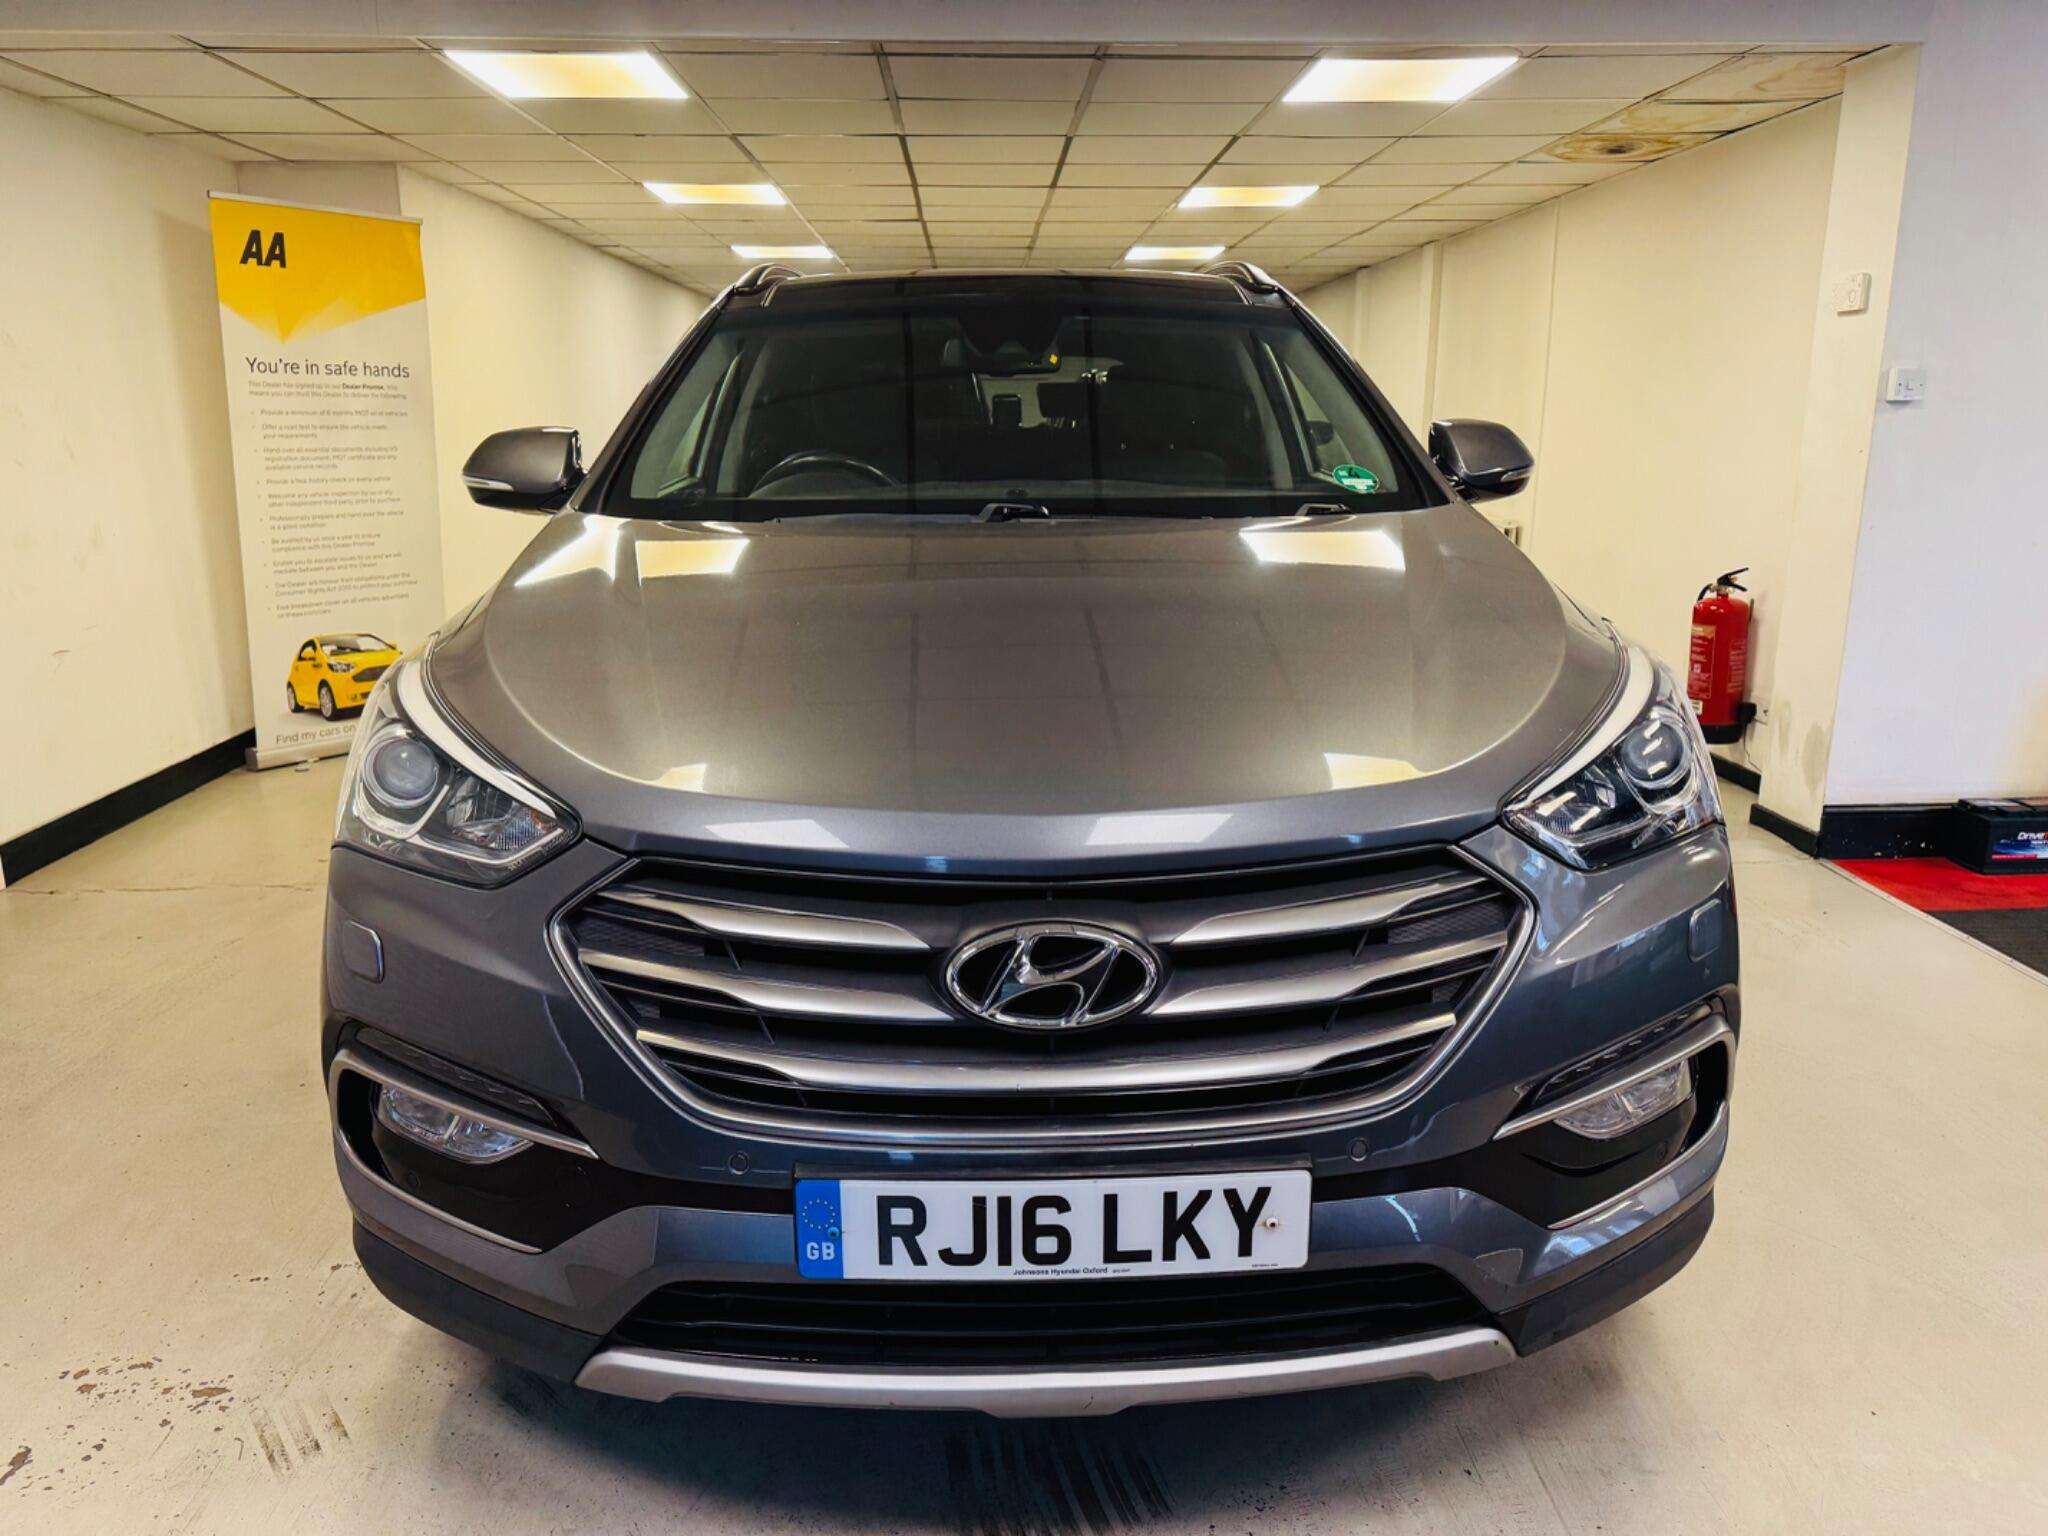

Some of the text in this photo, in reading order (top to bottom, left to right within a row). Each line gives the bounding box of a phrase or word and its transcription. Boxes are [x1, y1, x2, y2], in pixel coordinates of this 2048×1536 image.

[240, 230, 286, 268] AA
[245, 357, 410, 378] You're in safe hands
[276, 732, 299, 744] Find
[301, 730, 317, 741] my
[320, 727, 341, 737] cars
[876, 1187, 1272, 1266] RJ16 LKY
[806, 1241, 835, 1260] GB
